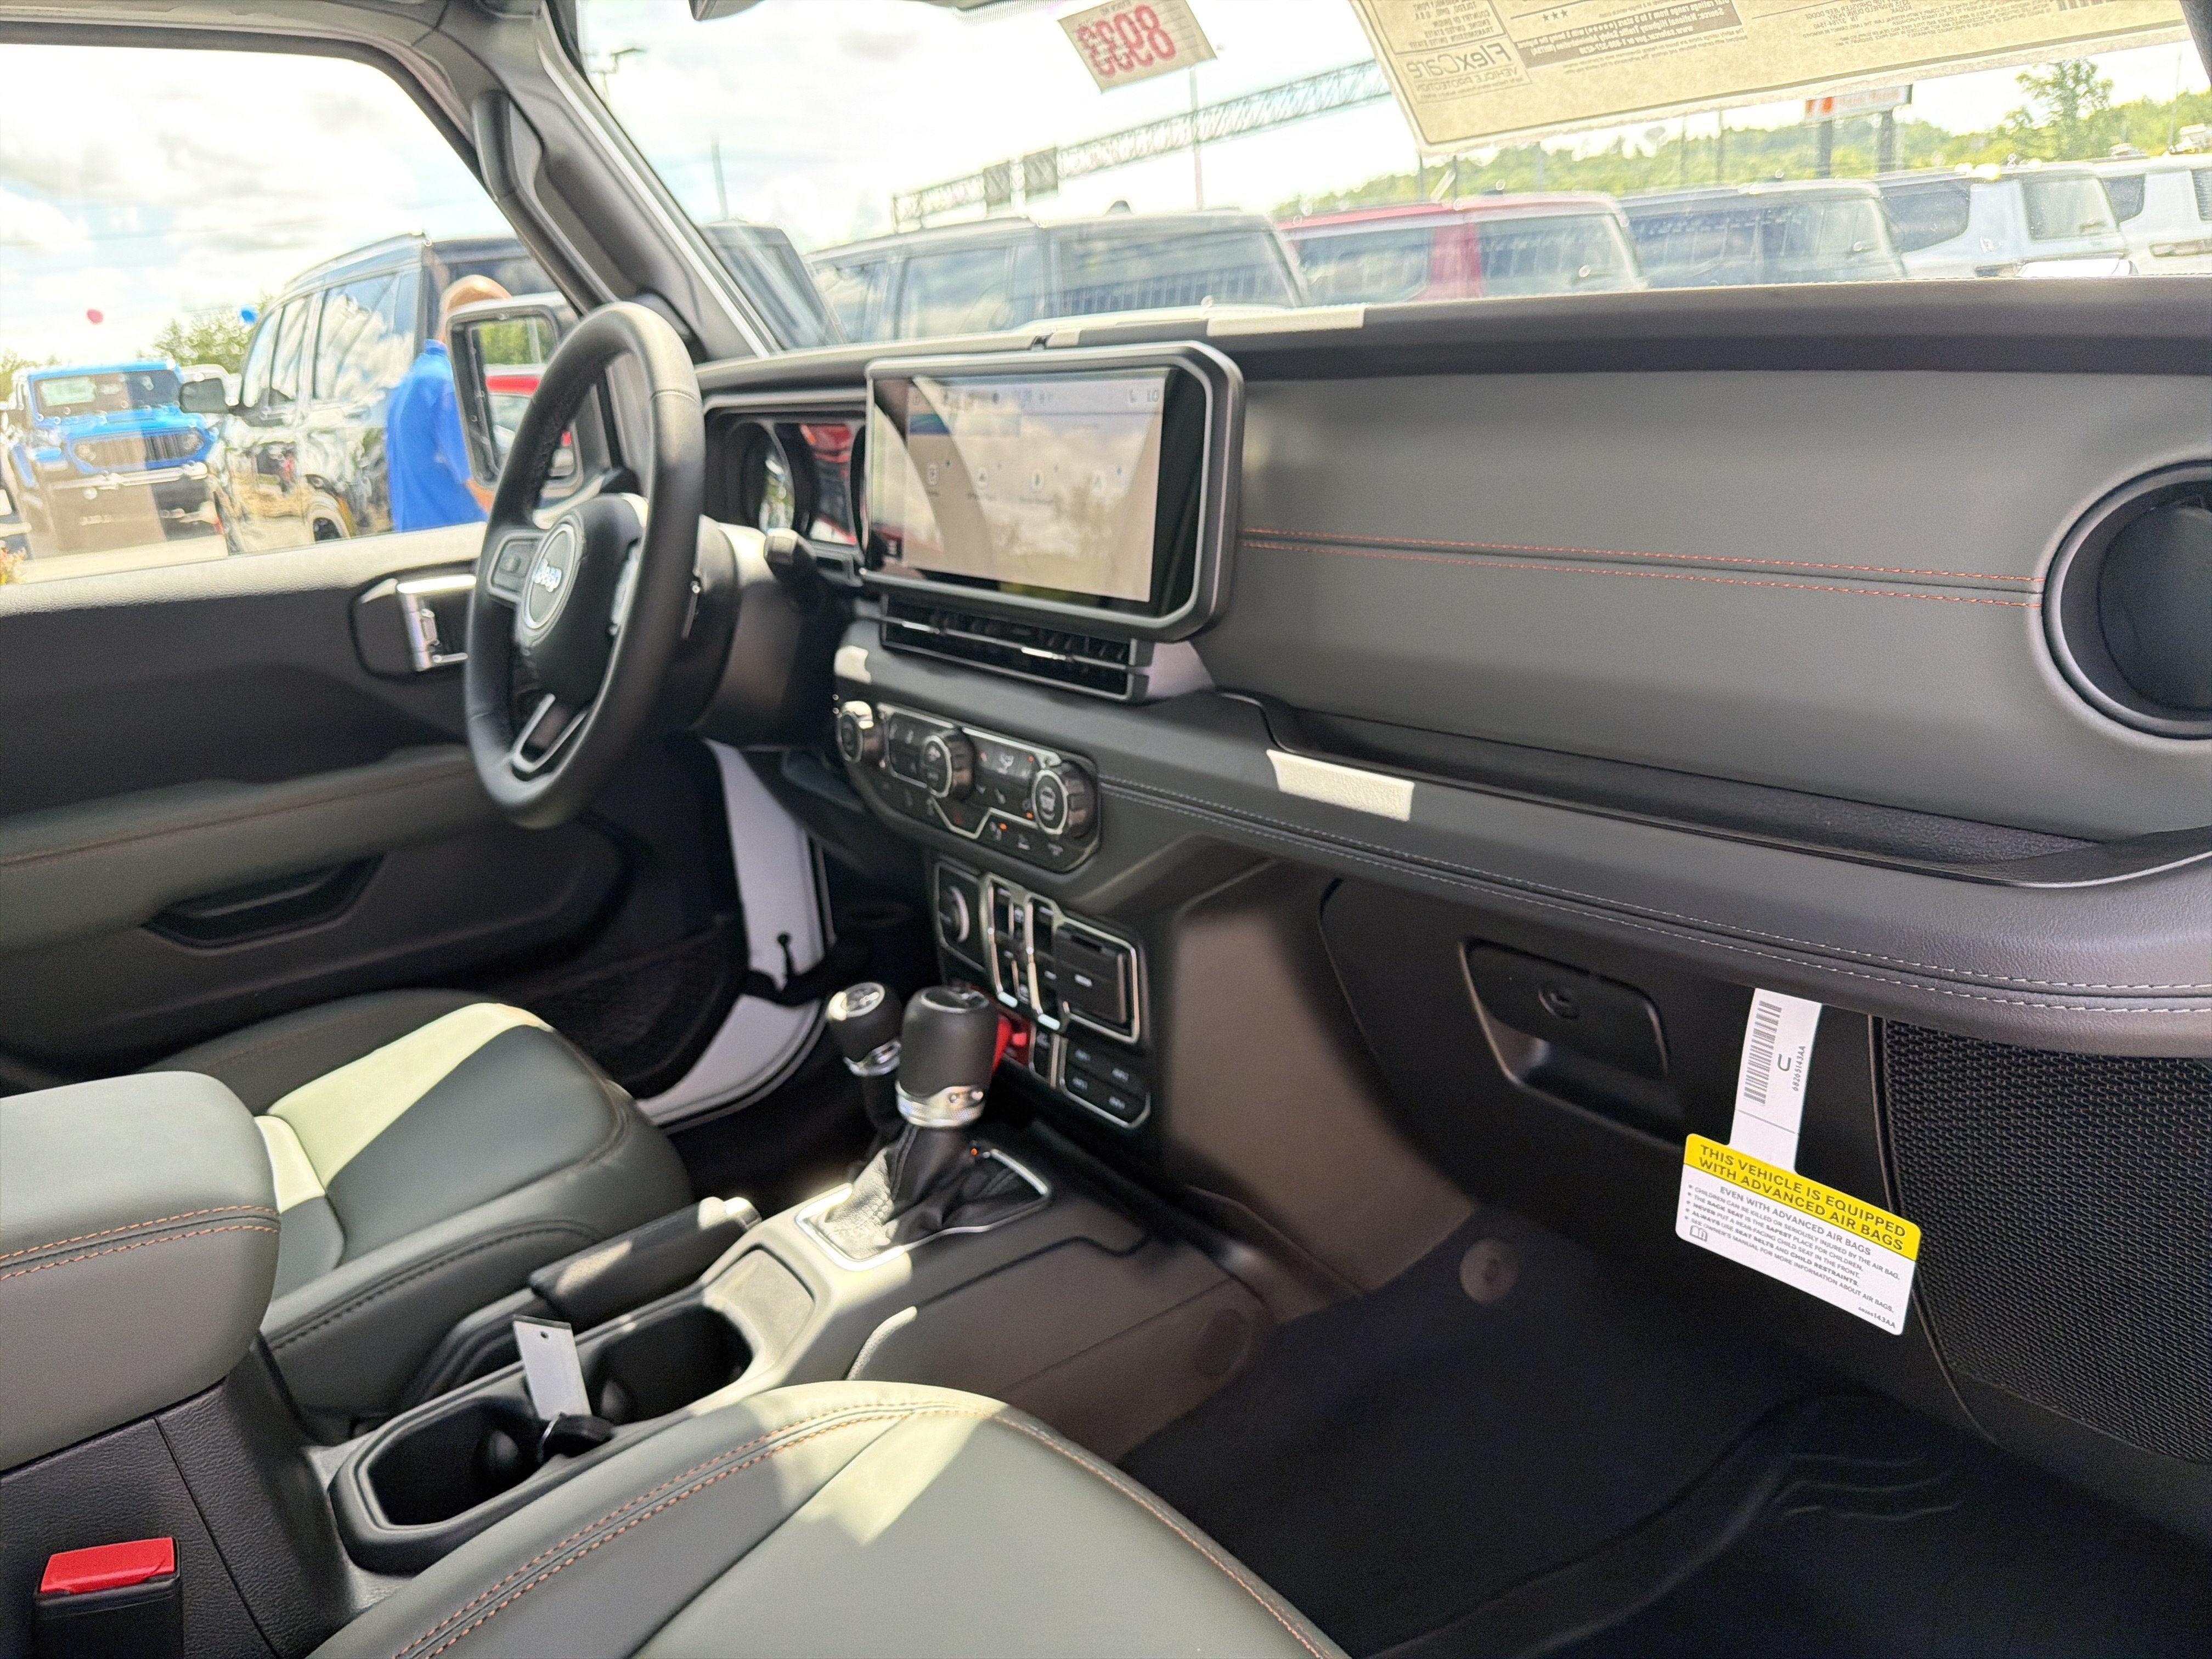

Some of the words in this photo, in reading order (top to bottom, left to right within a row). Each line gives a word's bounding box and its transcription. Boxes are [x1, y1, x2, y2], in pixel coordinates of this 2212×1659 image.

[1698, 1156, 1736, 1181] WITH
[1740, 1173, 1825, 1217] ADVANCED
[1829, 1210, 1856, 1230] AIR
[1860, 1223, 1903, 1251] BAGS
[1699, 1144, 1734, 1166] THIS
[1737, 1159, 1802, 1194] VEHICLE
[1806, 1187, 1821, 1201] IS
[1825, 1195, 1906, 1237] EQUIPPED
[1720, 1186, 1743, 1201] EVEN
[1745, 1196, 1770, 1212] WITH
[1772, 1207, 1824, 1235] ADVANCED
[1826, 1230, 1843, 1243] AIR
[1845, 1238, 1871, 1256] BAGS
[1695, 1186, 1725, 1204] CHILDREN
[1726, 1199, 1739, 1210] CAN
[1751, 1209, 1771, 1223] KILLED
[1773, 1219, 1782, 1227] OR
[1784, 1223, 1818, 1243] SERIOUSLY
[1819, 1238, 1847, 1255] INJURED
[1848, 1251, 1857, 1259] BY
[1858, 1256, 1870, 1266] THE
[1872, 1262, 1883, 1272] AIR
[1752, 1218, 1764, 1228] THE
[1793, 1235, 1813, 1248] PLACE
[1815, 1245, 1827, 1255] FOR
[1829, 1251, 1863, 1271] CHILDREN.
[1777, 1237, 1797, 1250] CHILD
[1798, 1246, 1813, 1257] SEAT
[1824, 1257, 1836, 1267] THE
[1837, 1263, 1860, 1278] FRONT.
[1760, 1246, 1772, 1256] FOR
[1774, 1252, 1792, 1265] MORE
[1793, 1261, 1837, 1285] INFORMATION
[1839, 1282, 1861, 1296] ABOUT
[1862, 1293, 1872, 1302] AIR
[1875, 1299, 1894, 1312] BAGS.
[1775, 1245, 1788, 1255] AND
[1790, 1251, 1812, 1265] CHILD
[1814, 1262, 1859, 1286] RESTRAINTS.
